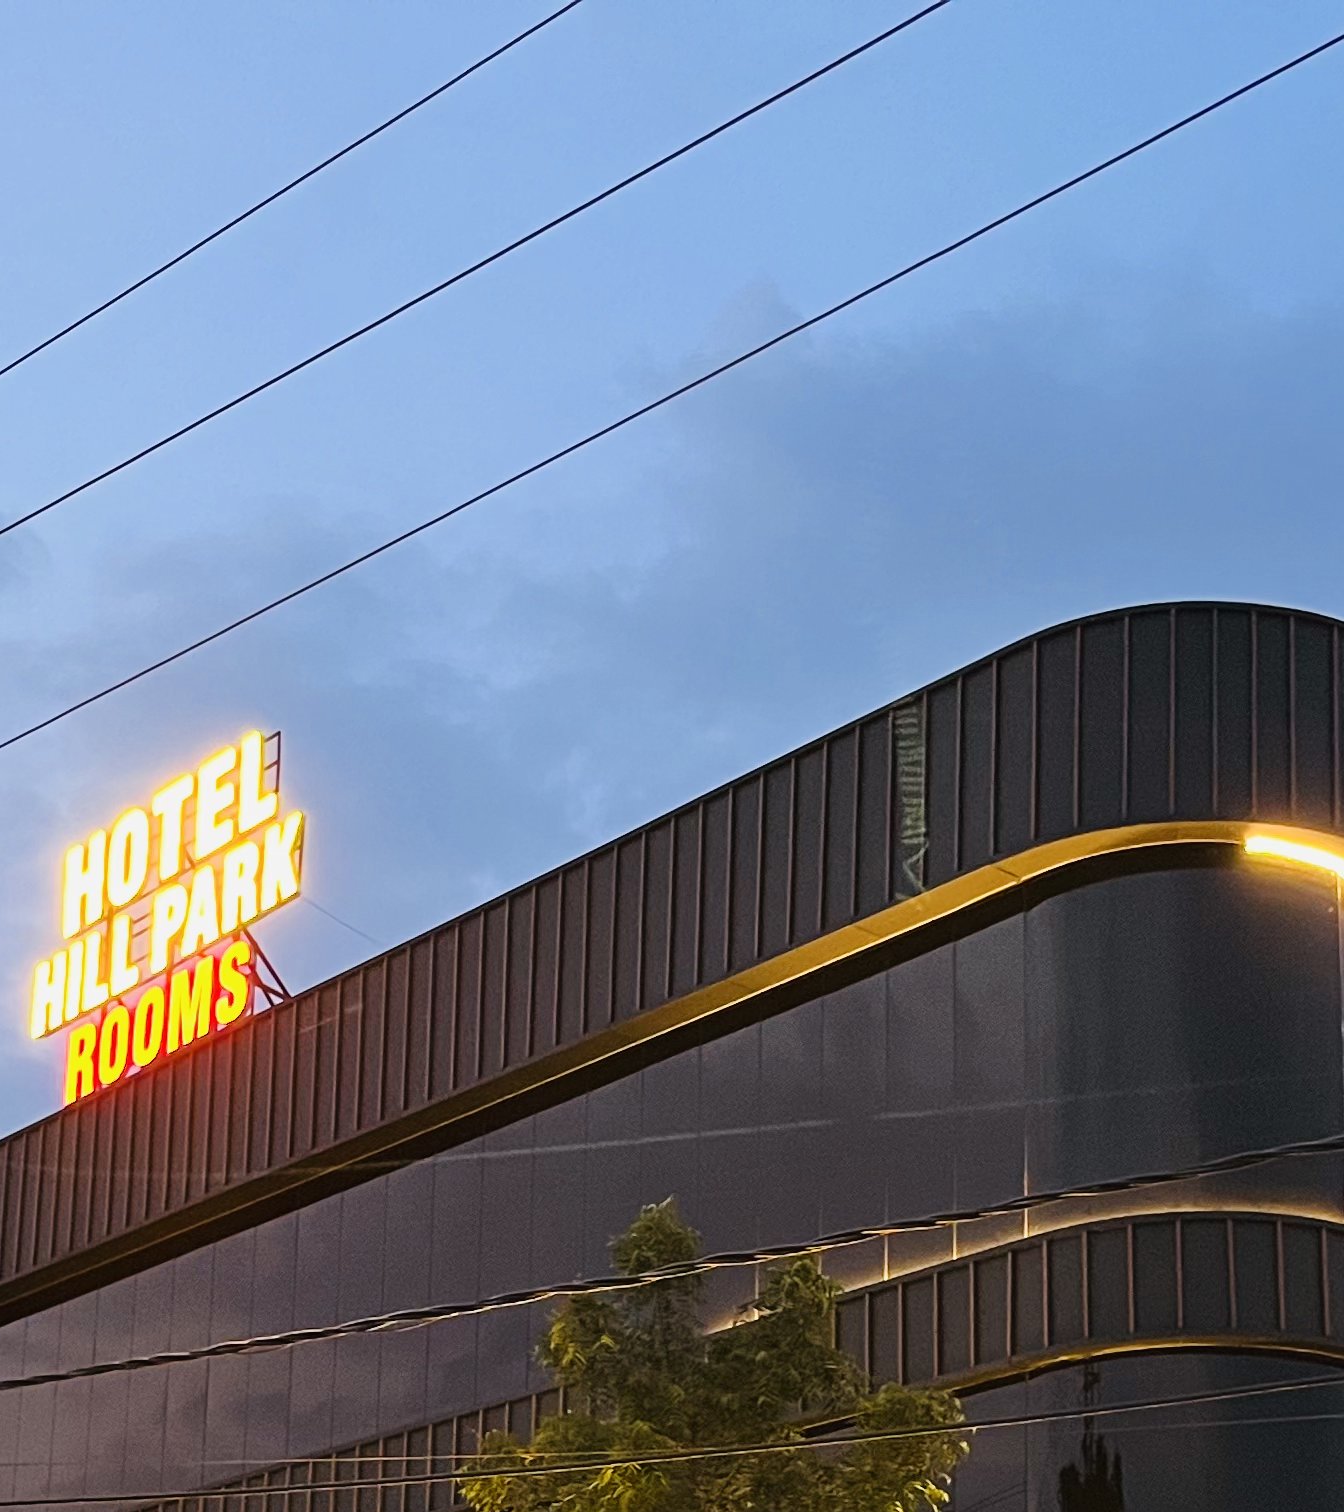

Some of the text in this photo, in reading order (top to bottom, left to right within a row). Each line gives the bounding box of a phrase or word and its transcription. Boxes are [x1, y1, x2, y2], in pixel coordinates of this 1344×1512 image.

[30, 809, 305, 1041] HILL PARK
[61, 729, 278, 940] HOTEL
[65, 939, 251, 1106] ROOMS
